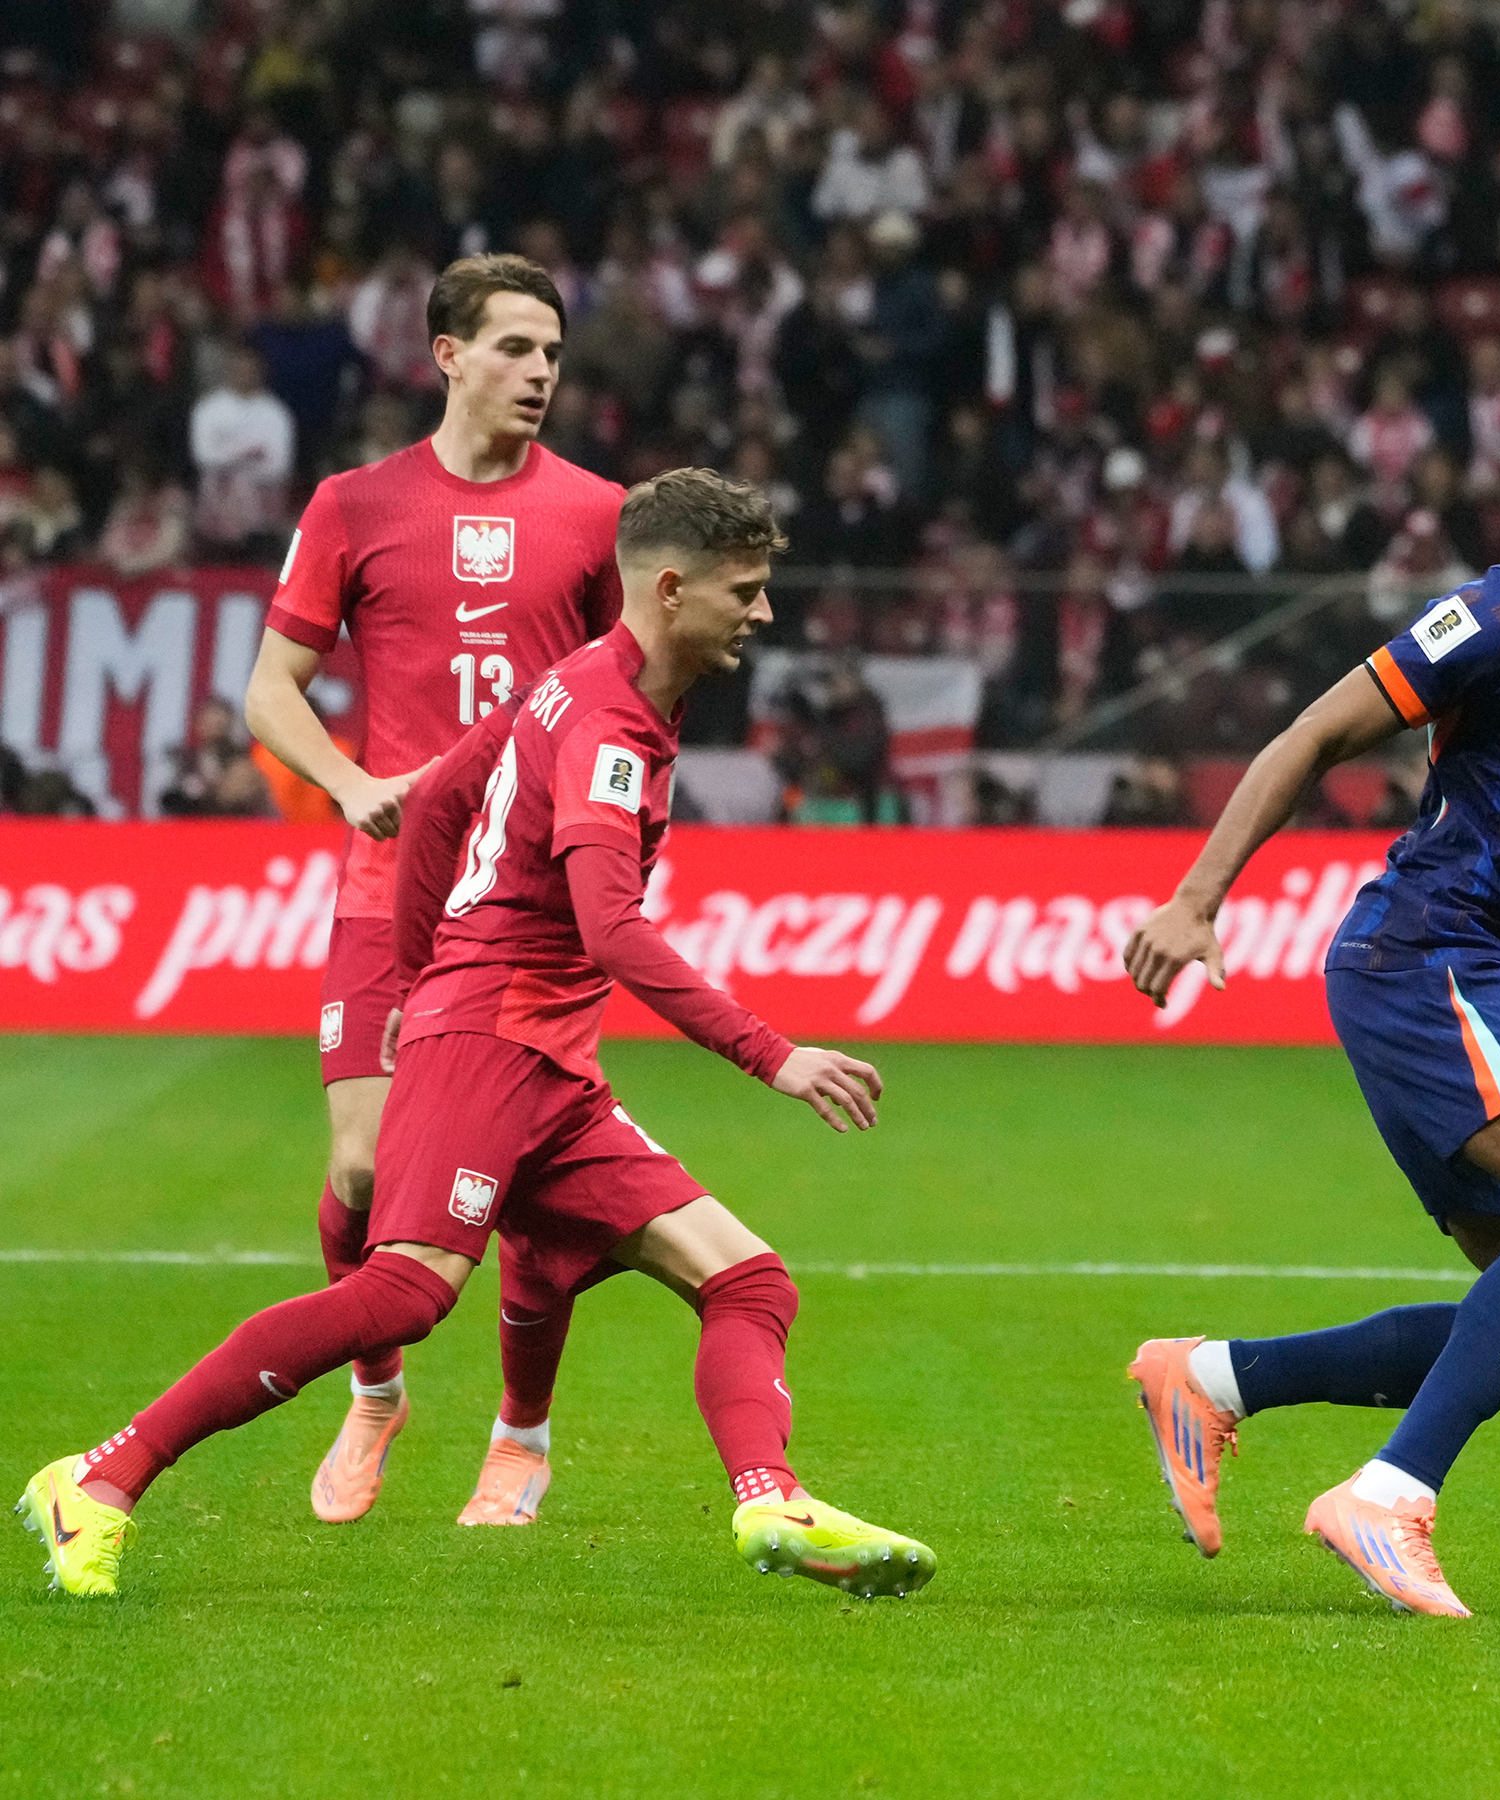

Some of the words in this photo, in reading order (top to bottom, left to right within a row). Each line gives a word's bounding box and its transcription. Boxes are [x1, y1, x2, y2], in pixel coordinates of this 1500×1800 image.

[450, 653, 515, 725] 13
[0, 883, 137, 985] as
[944, 893, 1158, 994] nas
